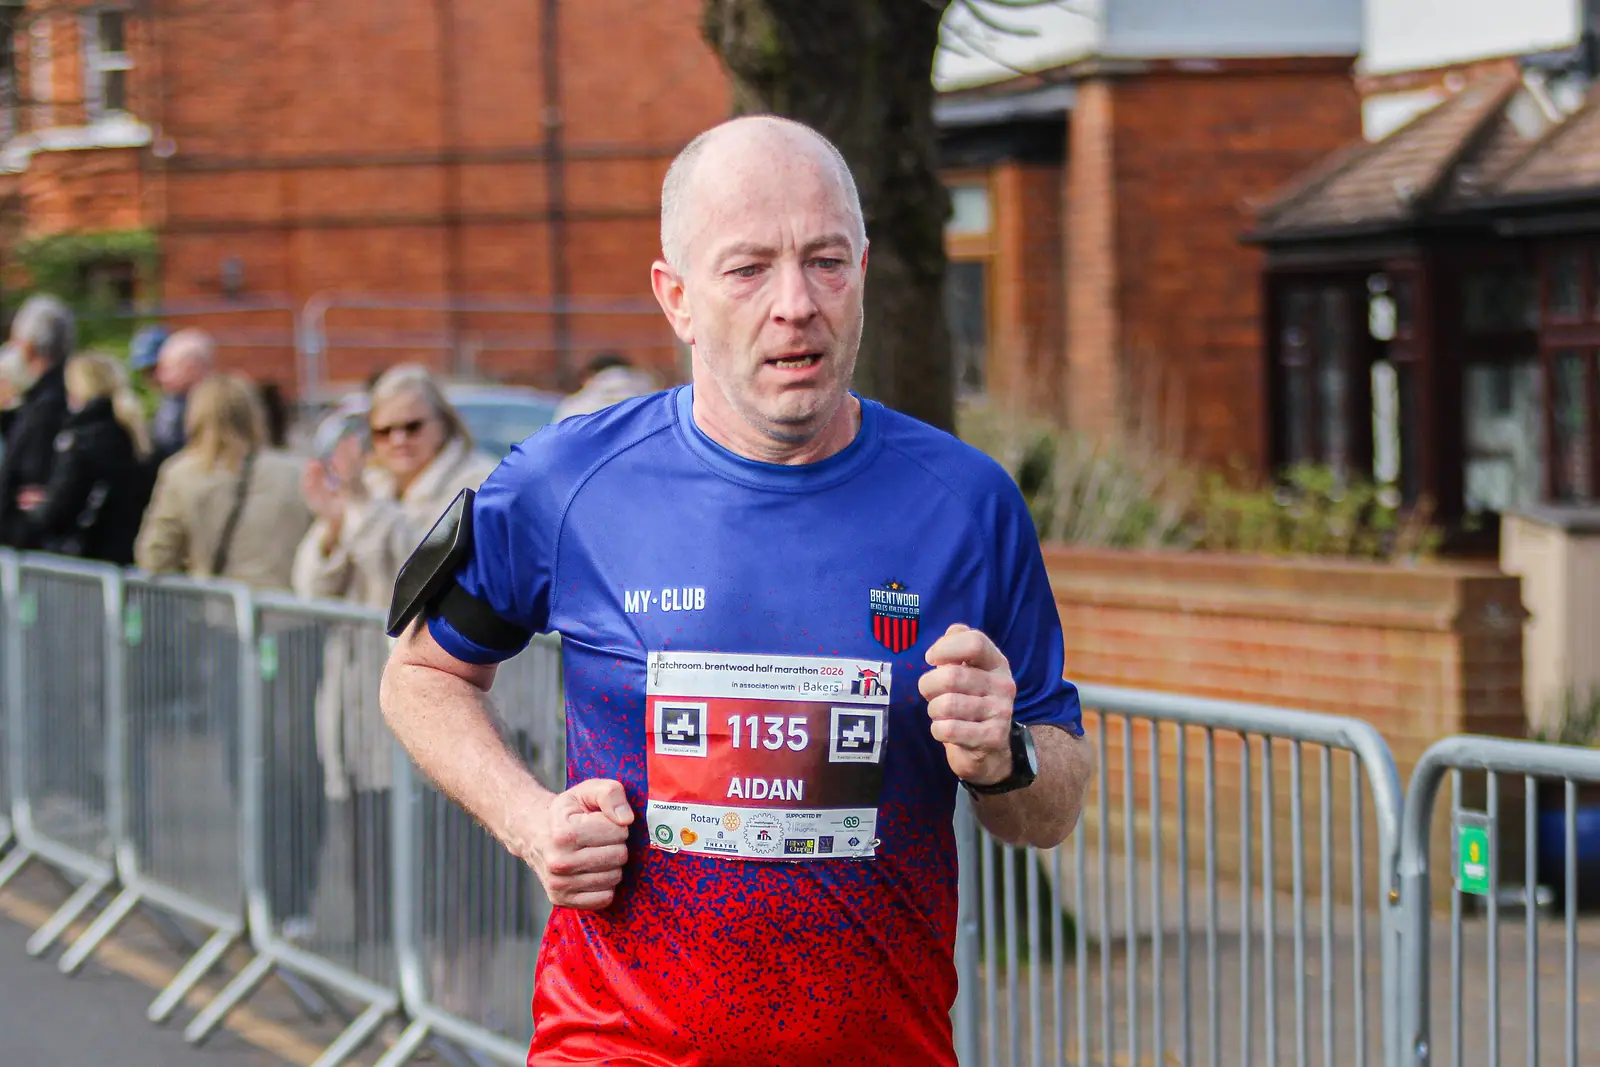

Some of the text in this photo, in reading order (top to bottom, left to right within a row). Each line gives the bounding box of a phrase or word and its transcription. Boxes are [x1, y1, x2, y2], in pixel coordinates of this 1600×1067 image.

[870, 589, 920, 607] BRENTWOOD
[704, 662, 754, 672] brentwood
[755, 664, 774, 673] half
[774, 666, 819, 675] marathon
[820, 667, 844, 676] 2026
[739, 682, 780, 690] association
[803, 682, 839, 692] Bakers
[727, 715, 809, 751] 1135
[726, 777, 804, 801] AIDAN
[690, 814, 721, 826] Rotary
